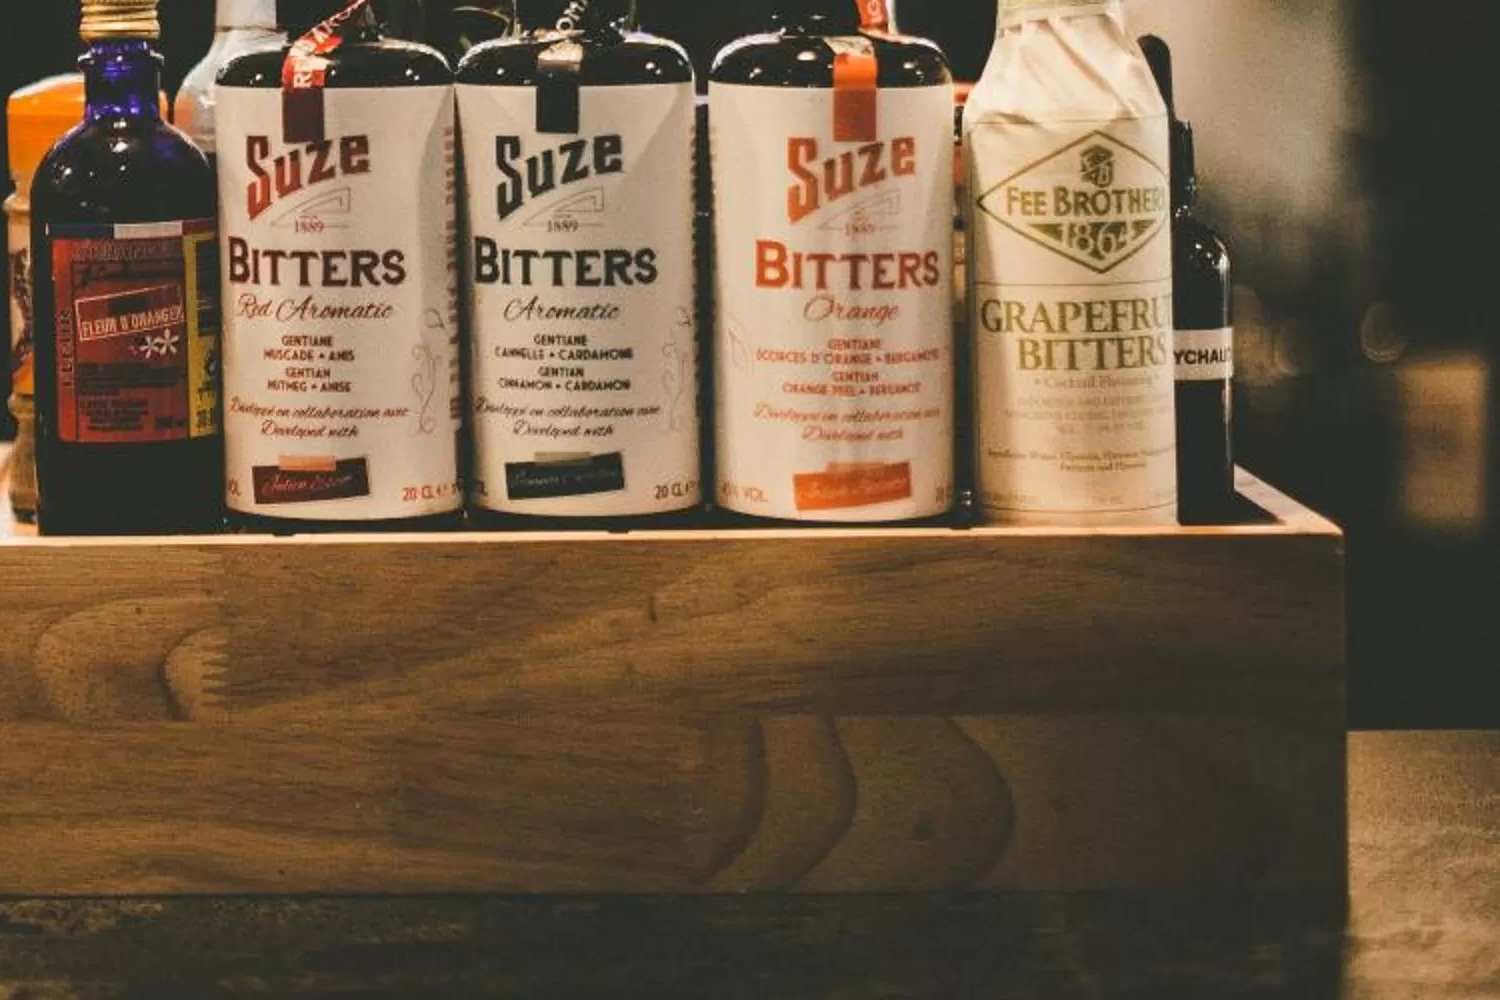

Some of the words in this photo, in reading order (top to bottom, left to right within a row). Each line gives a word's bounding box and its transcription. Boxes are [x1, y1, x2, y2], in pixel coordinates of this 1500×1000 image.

[245, 134, 373, 221] Suze
[495, 134, 626, 221] Suze
[787, 136, 917, 225] Suze
[1006, 186, 1047, 216] FEE
[228, 236, 407, 288] BITTERS
[474, 236, 659, 288] BITTERS
[755, 239, 940, 291] BITTERS
[236, 292, 273, 320] Red
[274, 295, 395, 322] Aromatic
[502, 295, 621, 322] Aromatic
[803, 294, 899, 327] Orange
[533, 334, 588, 346] GENTIANE
[1017, 333, 1168, 371] BITTERS
[1173, 347, 1231, 365] YCHAU
[537, 365, 585, 378] GENTIAN
